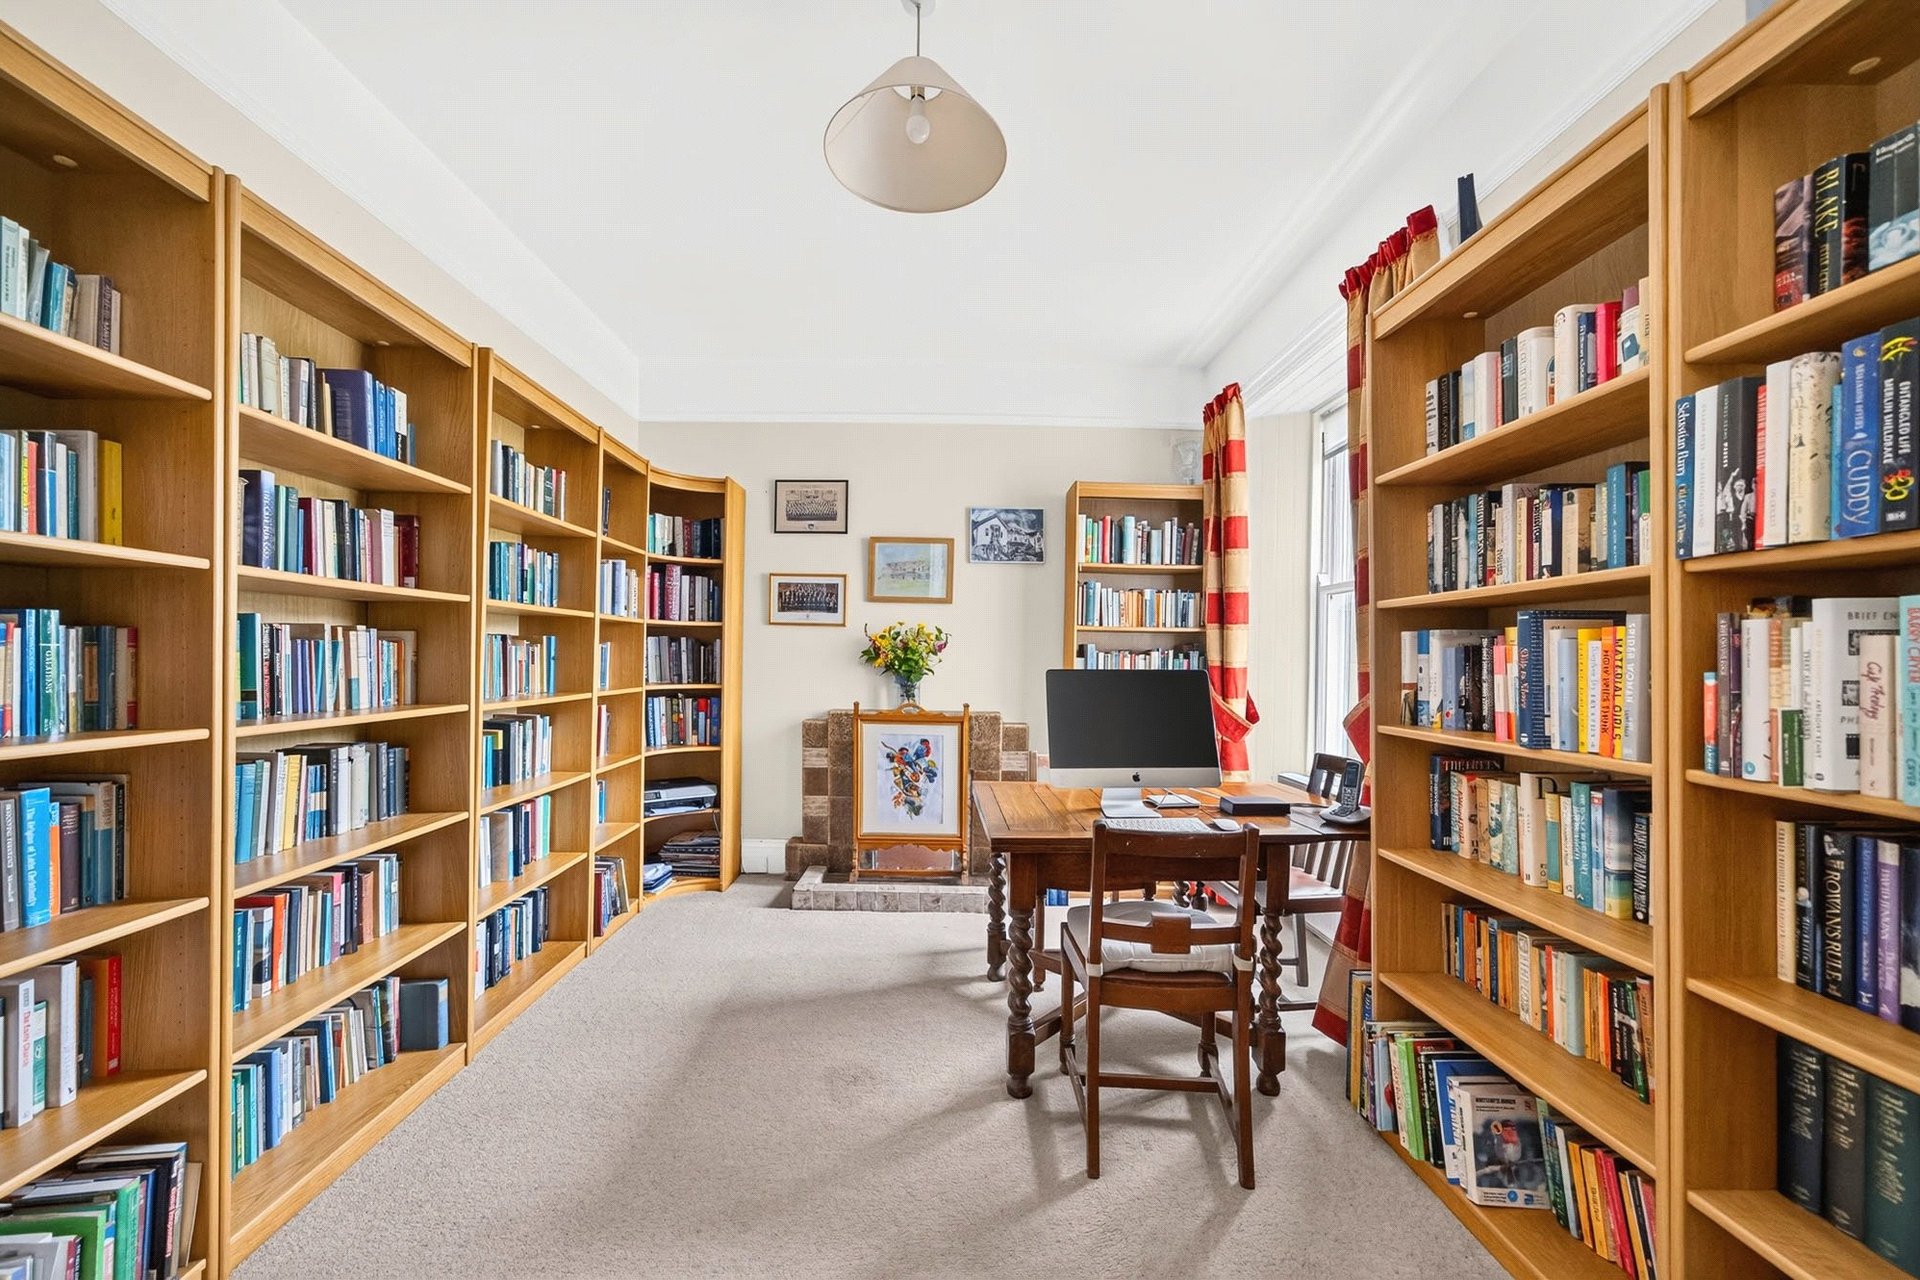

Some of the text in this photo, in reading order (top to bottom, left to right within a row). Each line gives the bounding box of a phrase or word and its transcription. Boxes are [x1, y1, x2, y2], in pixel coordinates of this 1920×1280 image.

[1815, 168, 1840, 237] BLAKE
[1883, 378, 1893, 413] MERLIN
[1898, 381, 1911, 454] ENTANGLED LIFE
[1677, 402, 1690, 450] Sebastian
[1843, 449, 1872, 524] CUDDY
[1627, 623, 1635, 659] SPIDER
[1847, 611, 1877, 621] BRIEF
[1614, 639, 1623, 701] MATERIAL
[1626, 662, 1635, 704] WOMAN
[1824, 870, 1841, 980] ROWAN'S RULE
